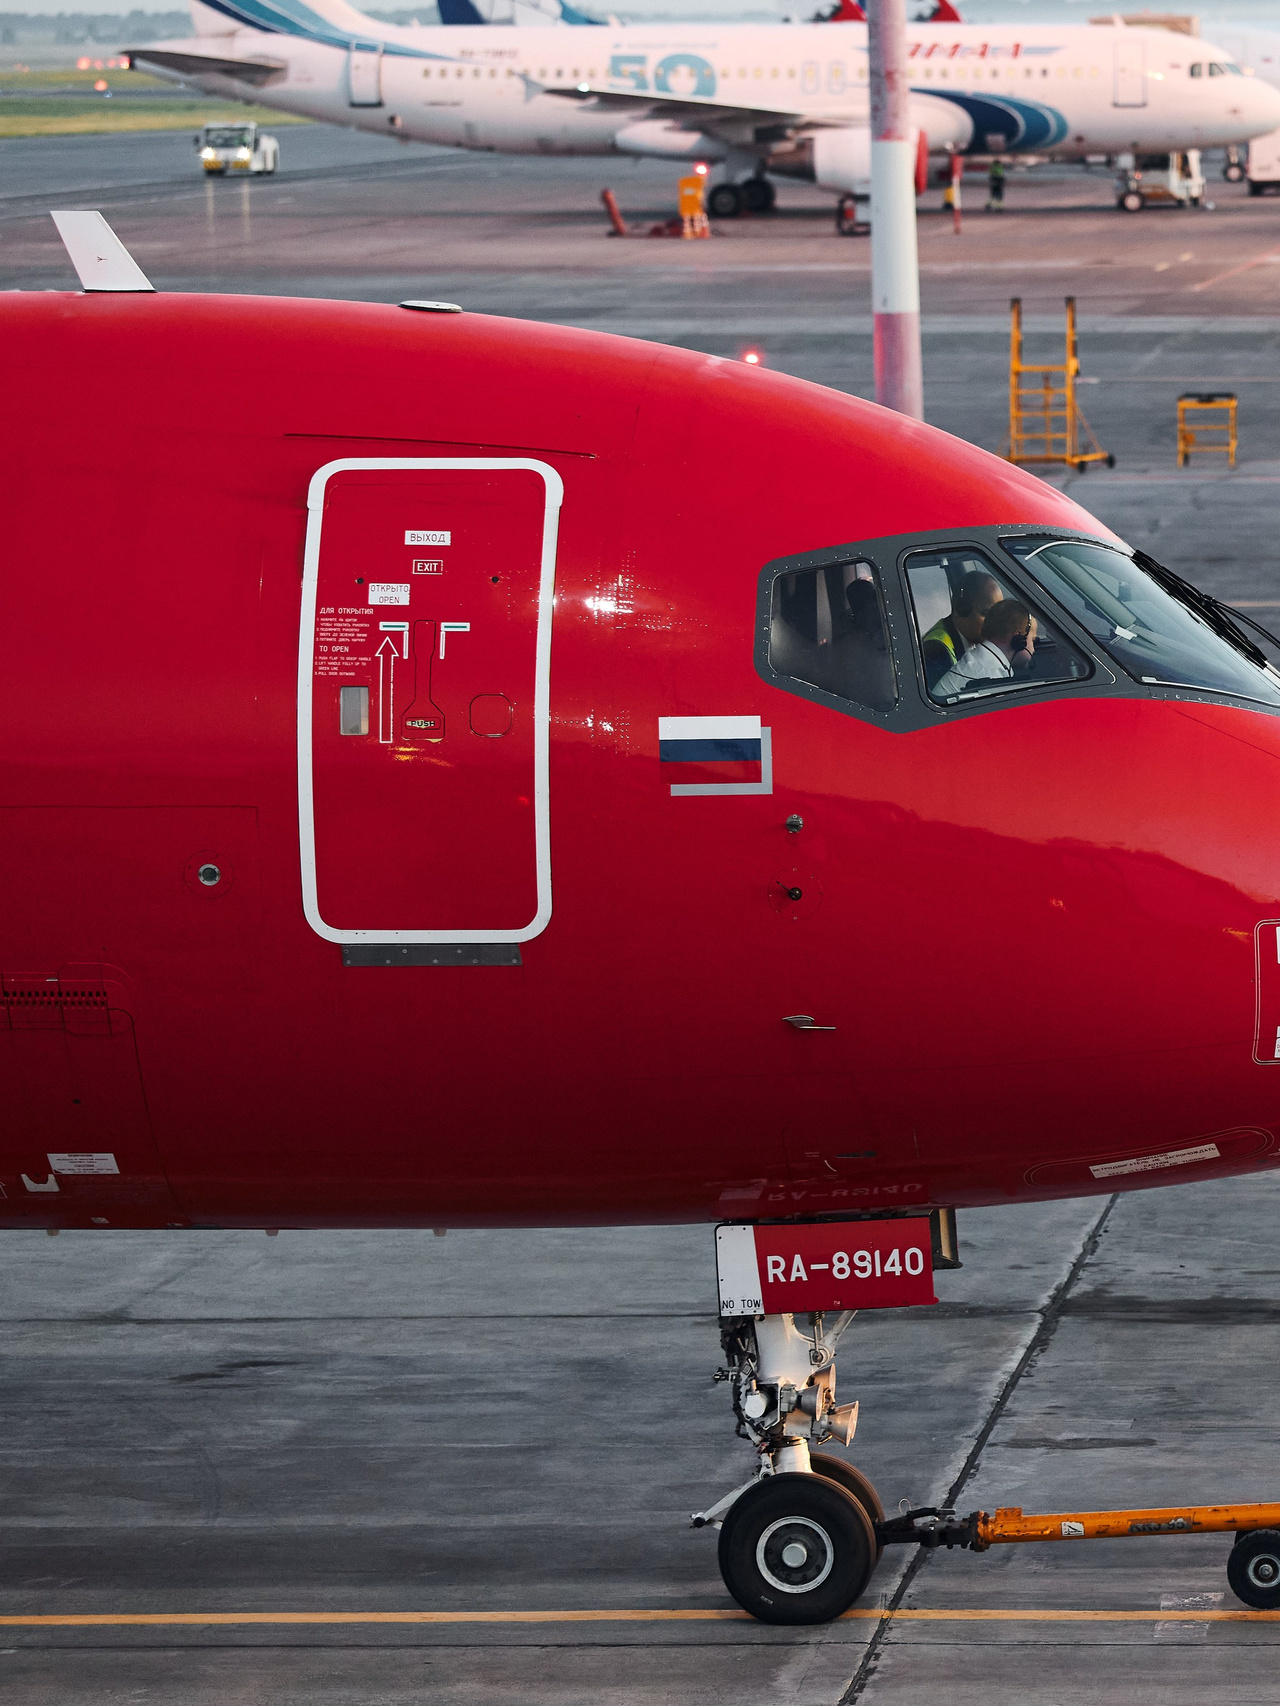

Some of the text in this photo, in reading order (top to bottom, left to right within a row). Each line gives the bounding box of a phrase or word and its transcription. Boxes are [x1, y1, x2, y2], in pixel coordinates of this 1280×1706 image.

[608, 53, 717, 97] 50
[410, 533, 446, 543] ВЫХОД
[417, 562, 439, 572] EXIT
[370, 585, 409, 593] ОТКРЫТО
[378, 596, 400, 604] OPEN
[319, 607, 374, 615] ДЛЯ ОТКРЫТИЯ
[331, 645, 349, 653] OPEN
[766, 1247, 924, 1283] RA-89140
[722, 1298, 761, 1309] NO TOW
